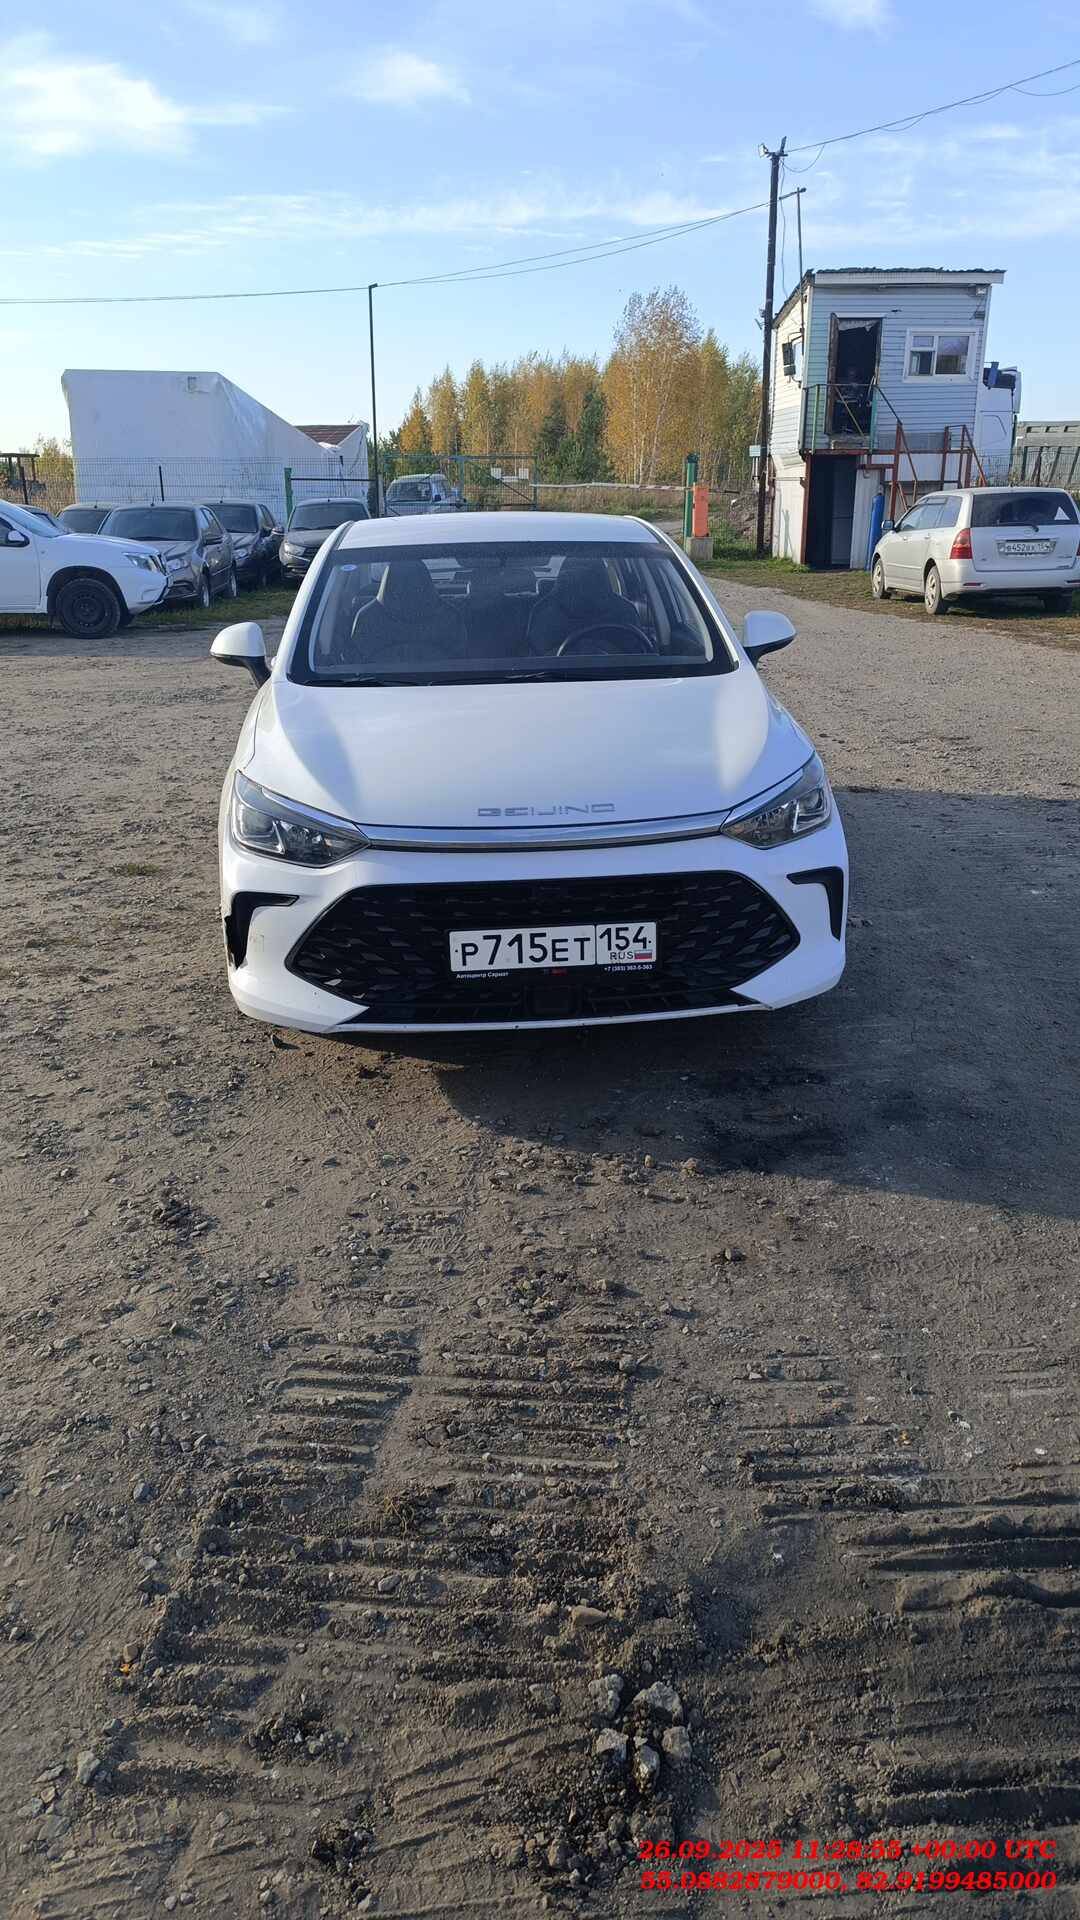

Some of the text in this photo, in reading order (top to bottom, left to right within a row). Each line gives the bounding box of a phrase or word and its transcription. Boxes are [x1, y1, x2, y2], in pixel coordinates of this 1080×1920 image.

[461, 926, 648, 966] Р715ЕТ 154
[610, 951, 634, 961] RUS
